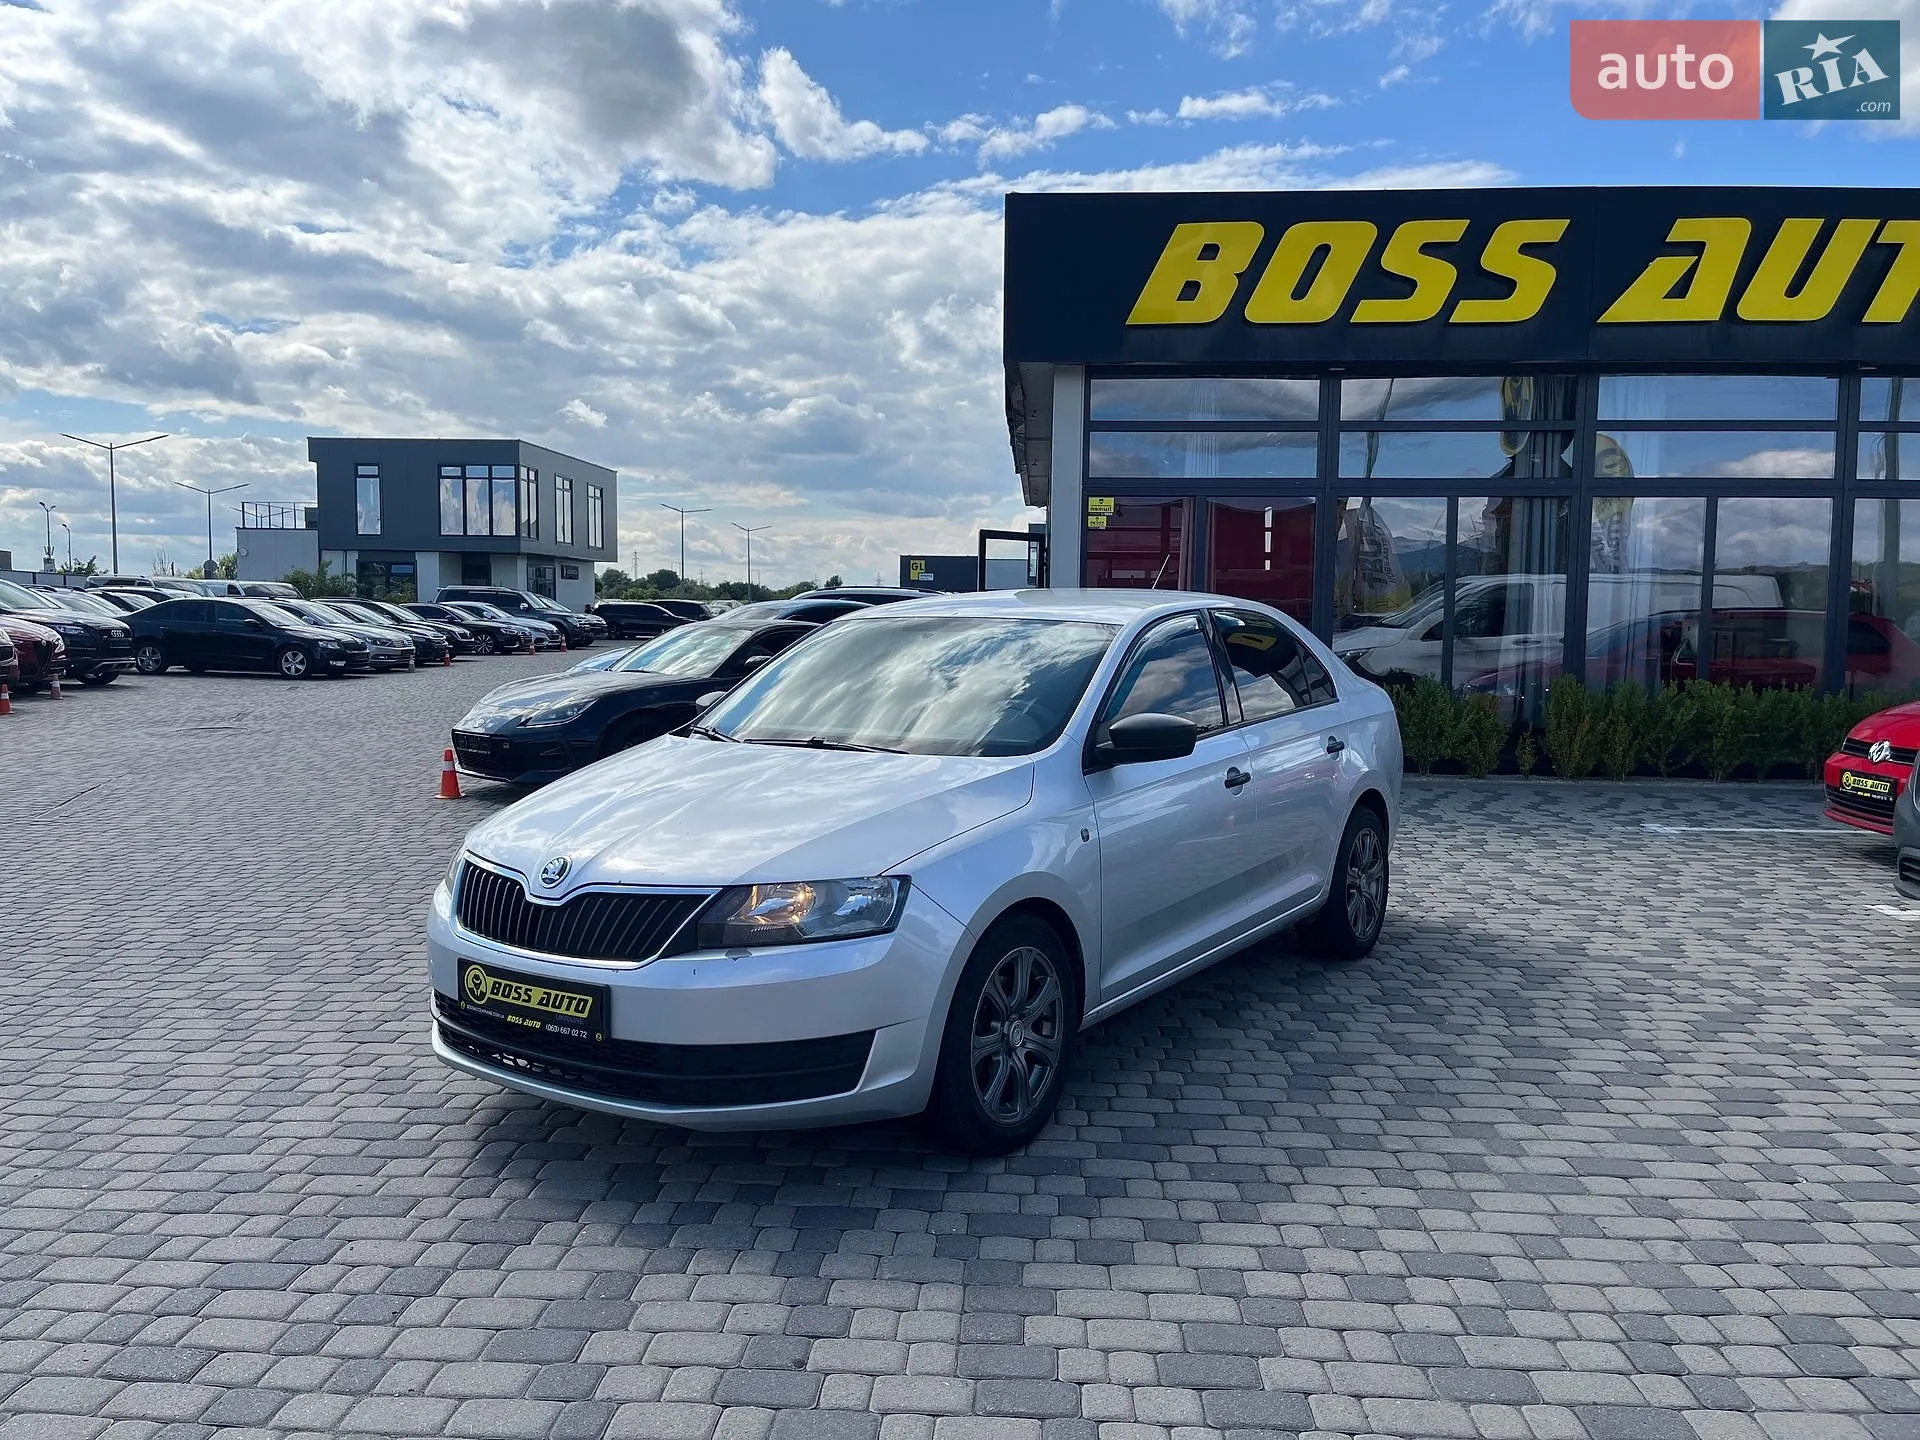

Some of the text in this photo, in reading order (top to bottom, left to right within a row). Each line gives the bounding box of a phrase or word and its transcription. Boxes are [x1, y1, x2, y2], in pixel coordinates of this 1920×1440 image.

[1125, 218, 1571, 325] BOSS
[911, 562, 925, 571] GL
[1870, 781, 1888, 791] AUTO
[490, 980, 588, 1014] BOSS AUTO
[506, 1015, 541, 1029] BOSS AUTO
